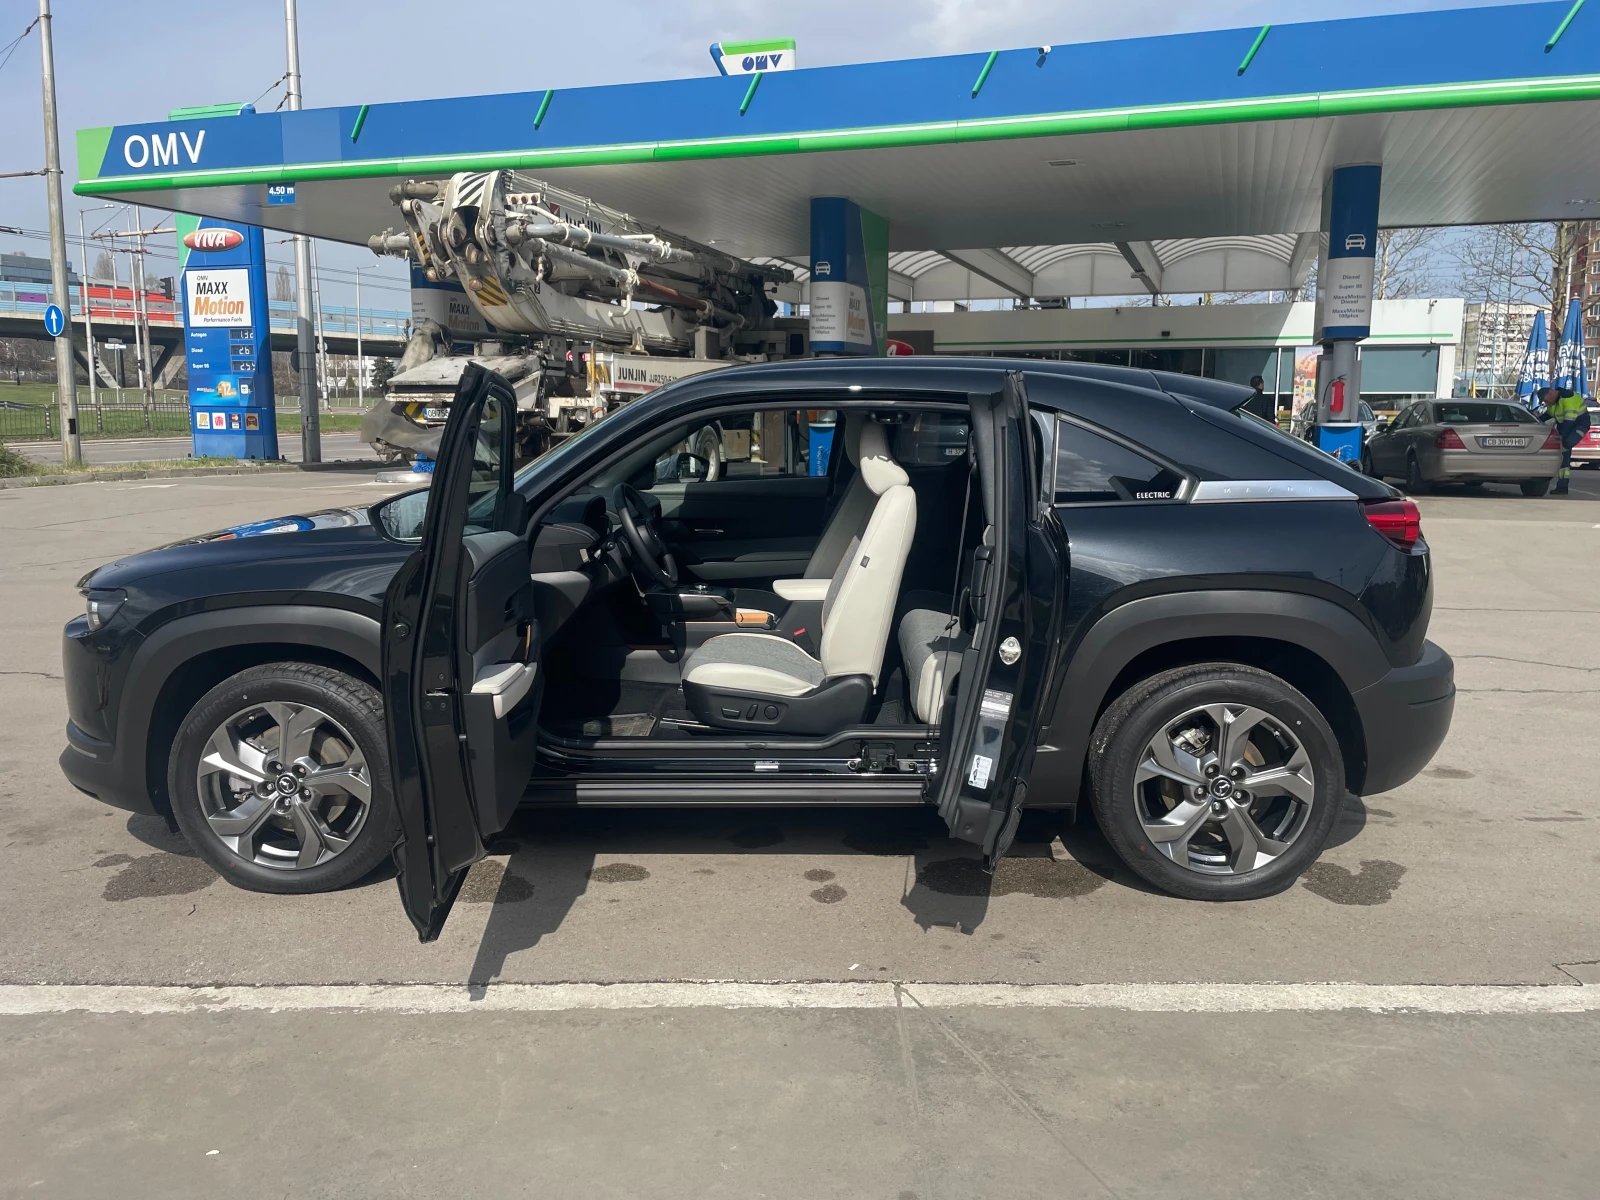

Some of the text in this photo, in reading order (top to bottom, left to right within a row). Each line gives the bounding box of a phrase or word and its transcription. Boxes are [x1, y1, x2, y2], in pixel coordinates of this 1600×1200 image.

[742, 54, 783, 72] OMV
[124, 130, 206, 168] OMV
[269, 186, 294, 195] 4.50 m
[194, 231, 227, 248] VIVA
[196, 281, 229, 295] MAXX
[193, 296, 245, 316] Motion
[449, 303, 470, 315] MAXX
[448, 315, 480, 331] Motion
[618, 367, 647, 382] JUNJIN
[1497, 438, 1514, 446] 3099
[1136, 491, 1171, 499] ELECTRIC
